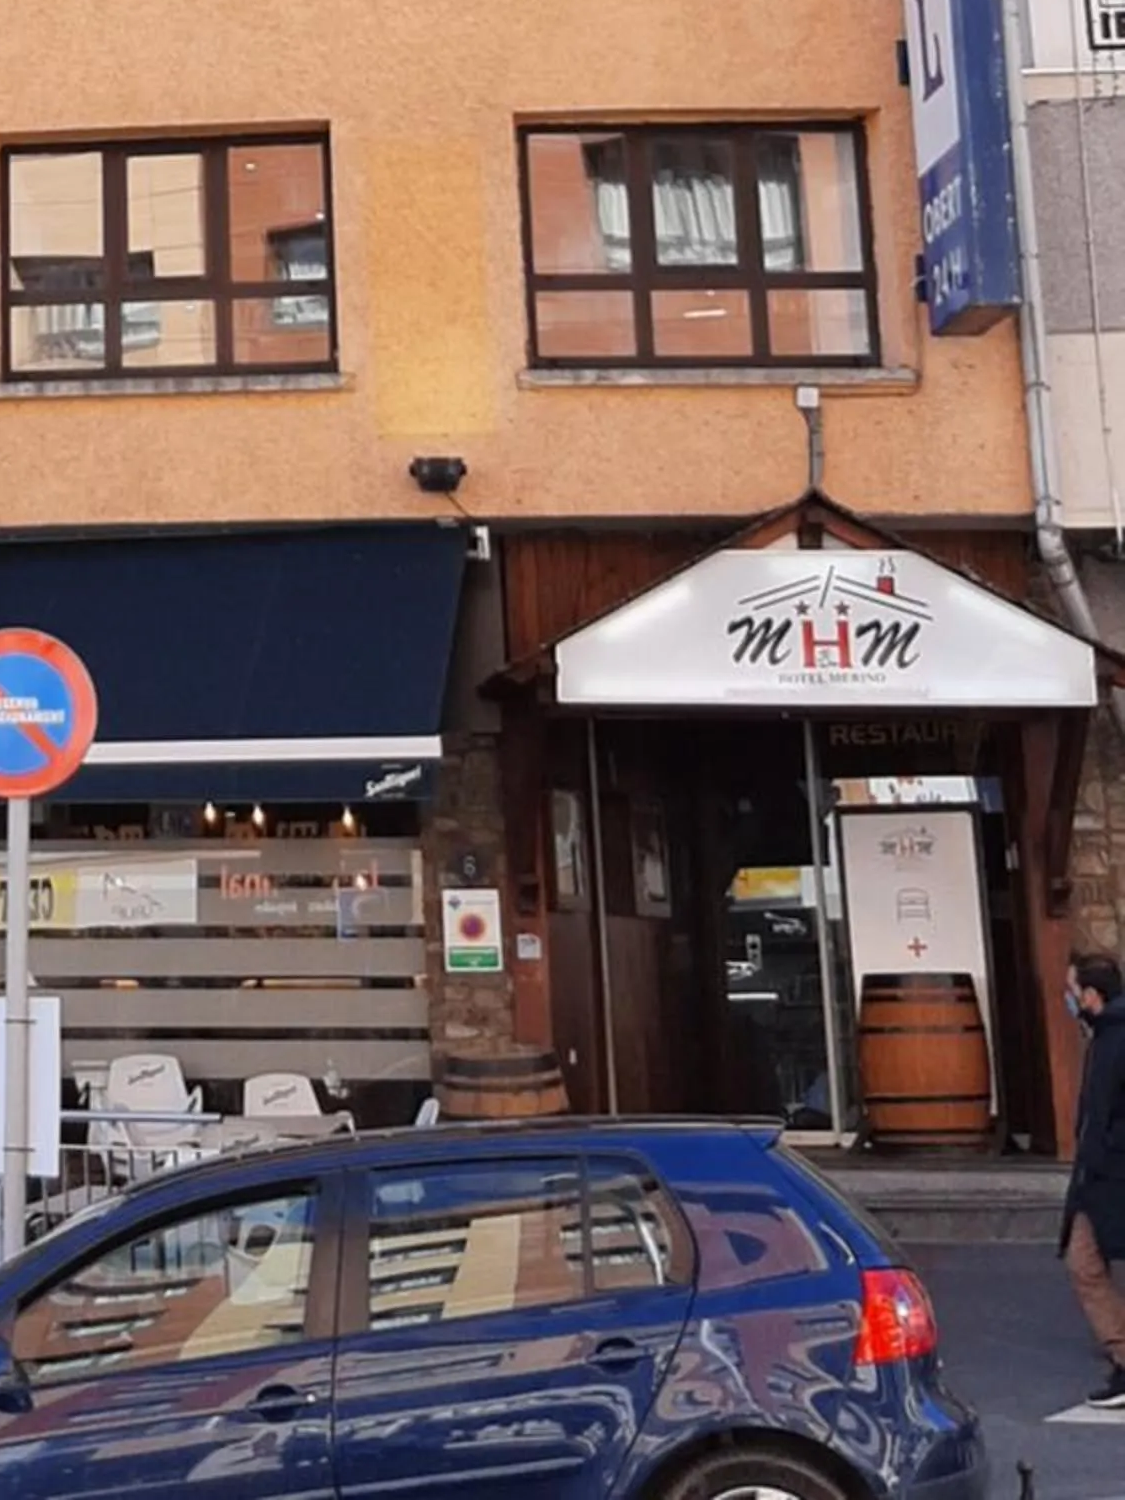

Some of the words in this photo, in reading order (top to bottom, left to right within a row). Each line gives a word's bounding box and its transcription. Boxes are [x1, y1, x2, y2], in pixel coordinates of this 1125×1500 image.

[923, 174, 962, 244] OBERT
[778, 672, 826, 684] HOTEL
[829, 672, 887, 684] MERINO
